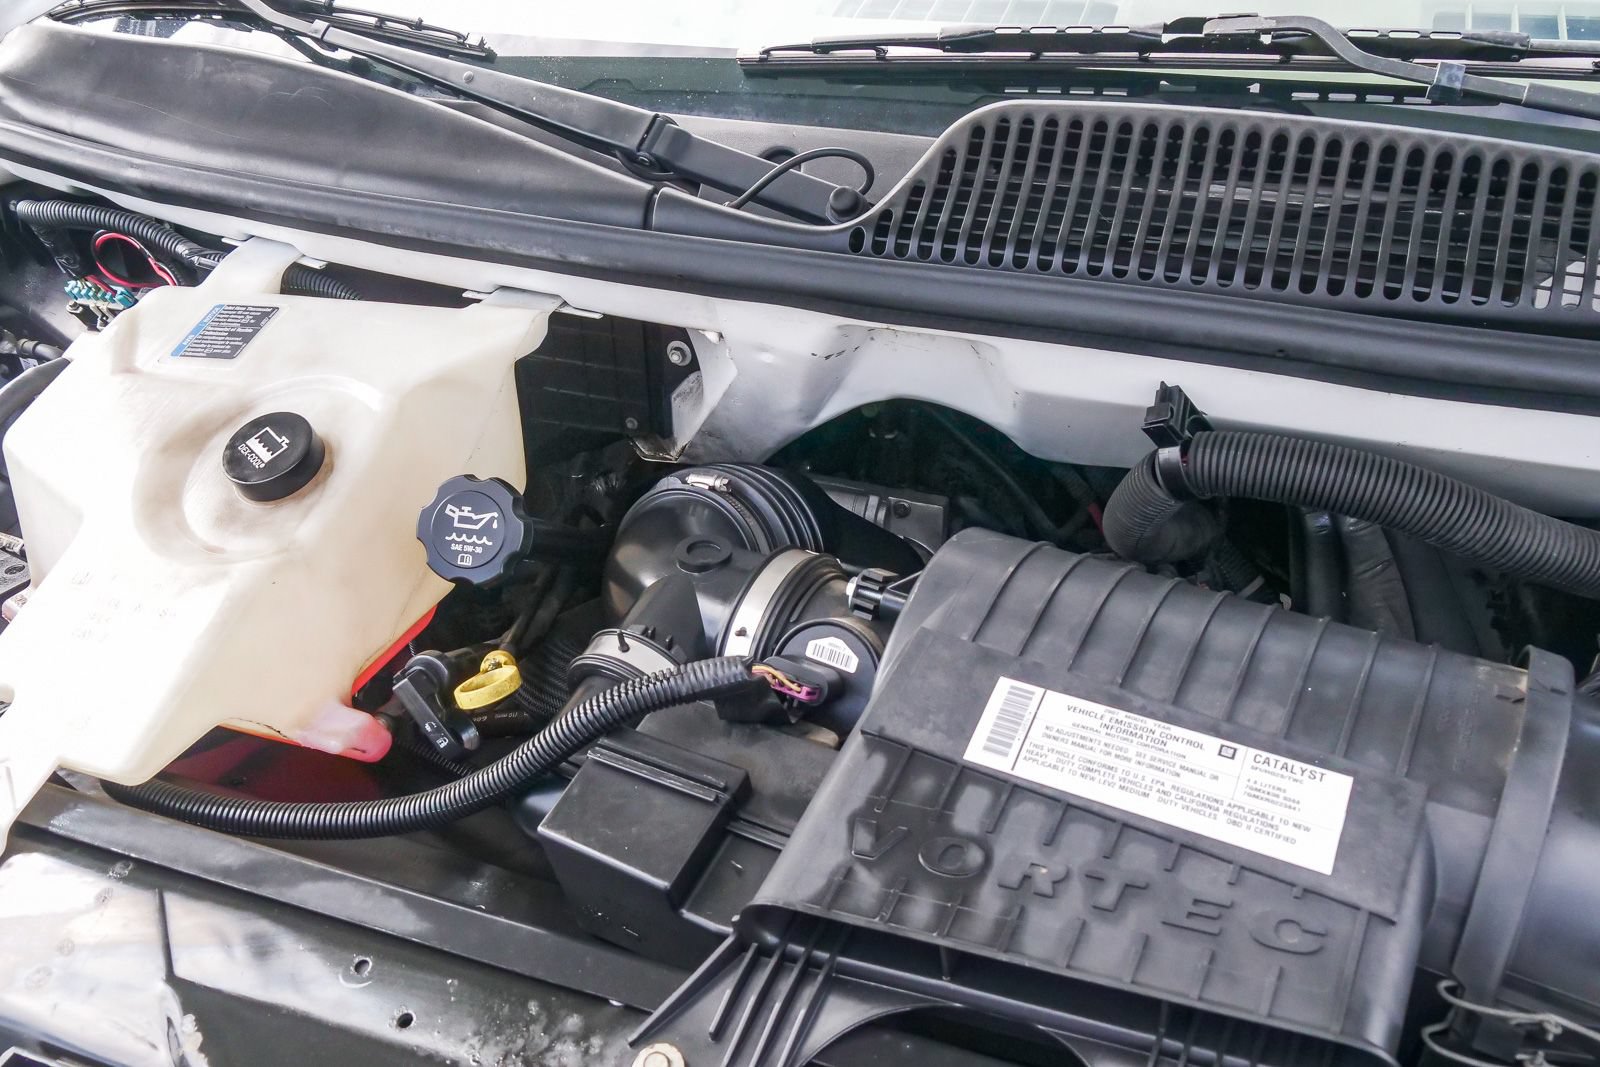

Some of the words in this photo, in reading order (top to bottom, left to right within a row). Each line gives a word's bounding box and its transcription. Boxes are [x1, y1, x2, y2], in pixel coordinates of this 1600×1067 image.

[450, 543, 463, 551] SAE
[463, 544, 483, 554] 5W-30
[1066, 704, 1106, 721] VEHICLE
[1108, 716, 1156, 735] EMISSION
[1158, 731, 1206, 750] CONTROL
[1071, 722, 1101, 734] GENERAL
[1104, 731, 1133, 743] MOTORS
[1136, 740, 1186, 759] CORPORATION
[1099, 721, 1167, 746] INFORMATION
[1055, 728, 1101, 746] ADJUSTMENTS
[1102, 741, 1128, 754] NEEDED
[1134, 751, 1146, 759] SEE
[1149, 755, 1176, 768] SERVICE
[1178, 764, 1207, 777] MANUAL
[1070, 740, 1097, 752] MANUAL
[1098, 748, 1112, 757] FOR
[1114, 753, 1132, 763] MORE
[1134, 759, 1181, 777] INFORMATION
[1252, 753, 1326, 783] CATALYST
[1022, 754, 1065, 772] APPLICABLE
[1079, 772, 1096, 782] NEW
[1118, 784, 1150, 798] MEDIUM
[1156, 796, 1178, 807] DUTY
[1180, 803, 1218, 820] VEHICLES
[1253, 826, 1297, 844] CERTIFIED
[1025, 748, 1048, 759] HEAVY
[1055, 757, 1074, 767] DUTY
[1077, 763, 1115, 780] COMPLETE
[1117, 776, 1153, 792] VEHICLES
[1155, 787, 1172, 797] AND
[1174, 793, 1220, 812] CALIFORNIA
[1222, 808, 1280, 831] REGULATIONS
[1028, 741, 1044, 750] THIS
[1046, 746, 1075, 760] VEHICLE
[1077, 756, 1118, 773] CONFORMS
[1150, 778, 1165, 788] EPA
[1170, 784, 1224, 806] REGULATIONS
[1226, 801, 1274, 821] APPLICABLE
[1291, 821, 1311, 832] NEW
[851, 818, 1329, 955] VORTEC
